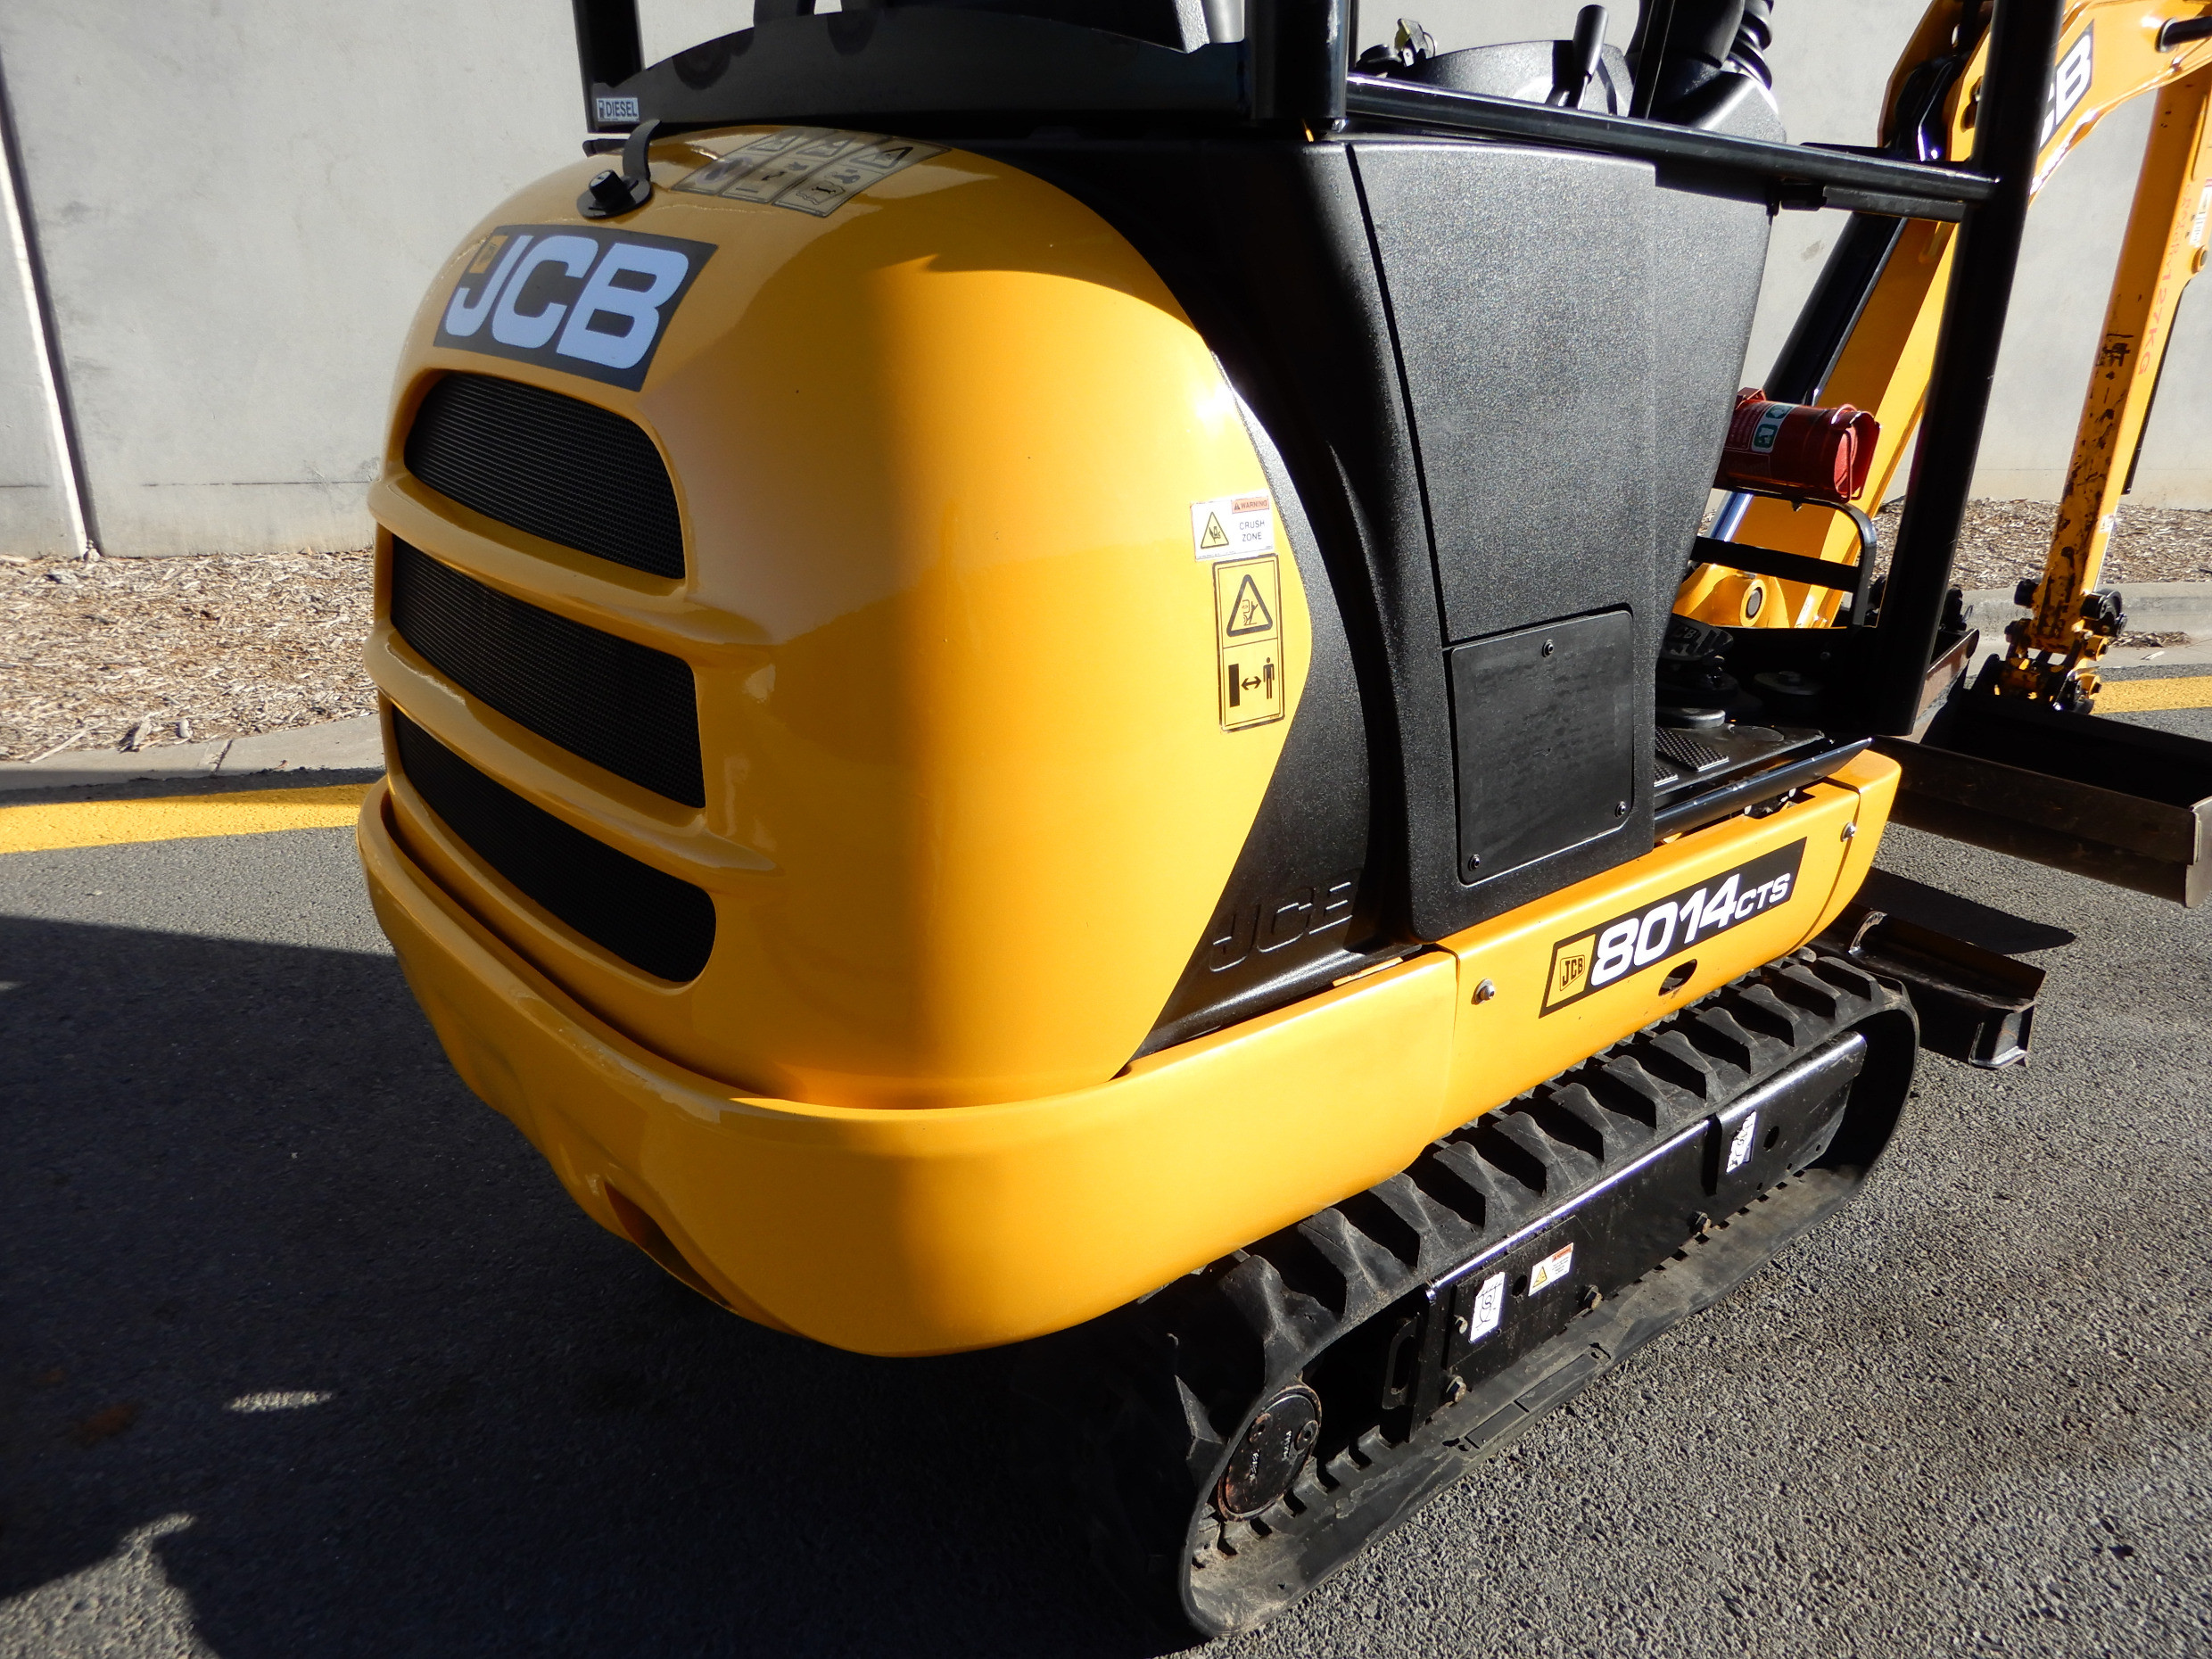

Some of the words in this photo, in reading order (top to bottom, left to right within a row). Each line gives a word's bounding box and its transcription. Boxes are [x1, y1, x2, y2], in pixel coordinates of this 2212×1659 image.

[606, 100, 638, 117] DIESEL
[446, 234, 689, 369] JCB
[1240, 499, 1267, 509] WARNING
[1239, 519, 1265, 531] CRUSH
[1242, 532, 1262, 542] ZONE
[1562, 957, 1583, 987] JCB
